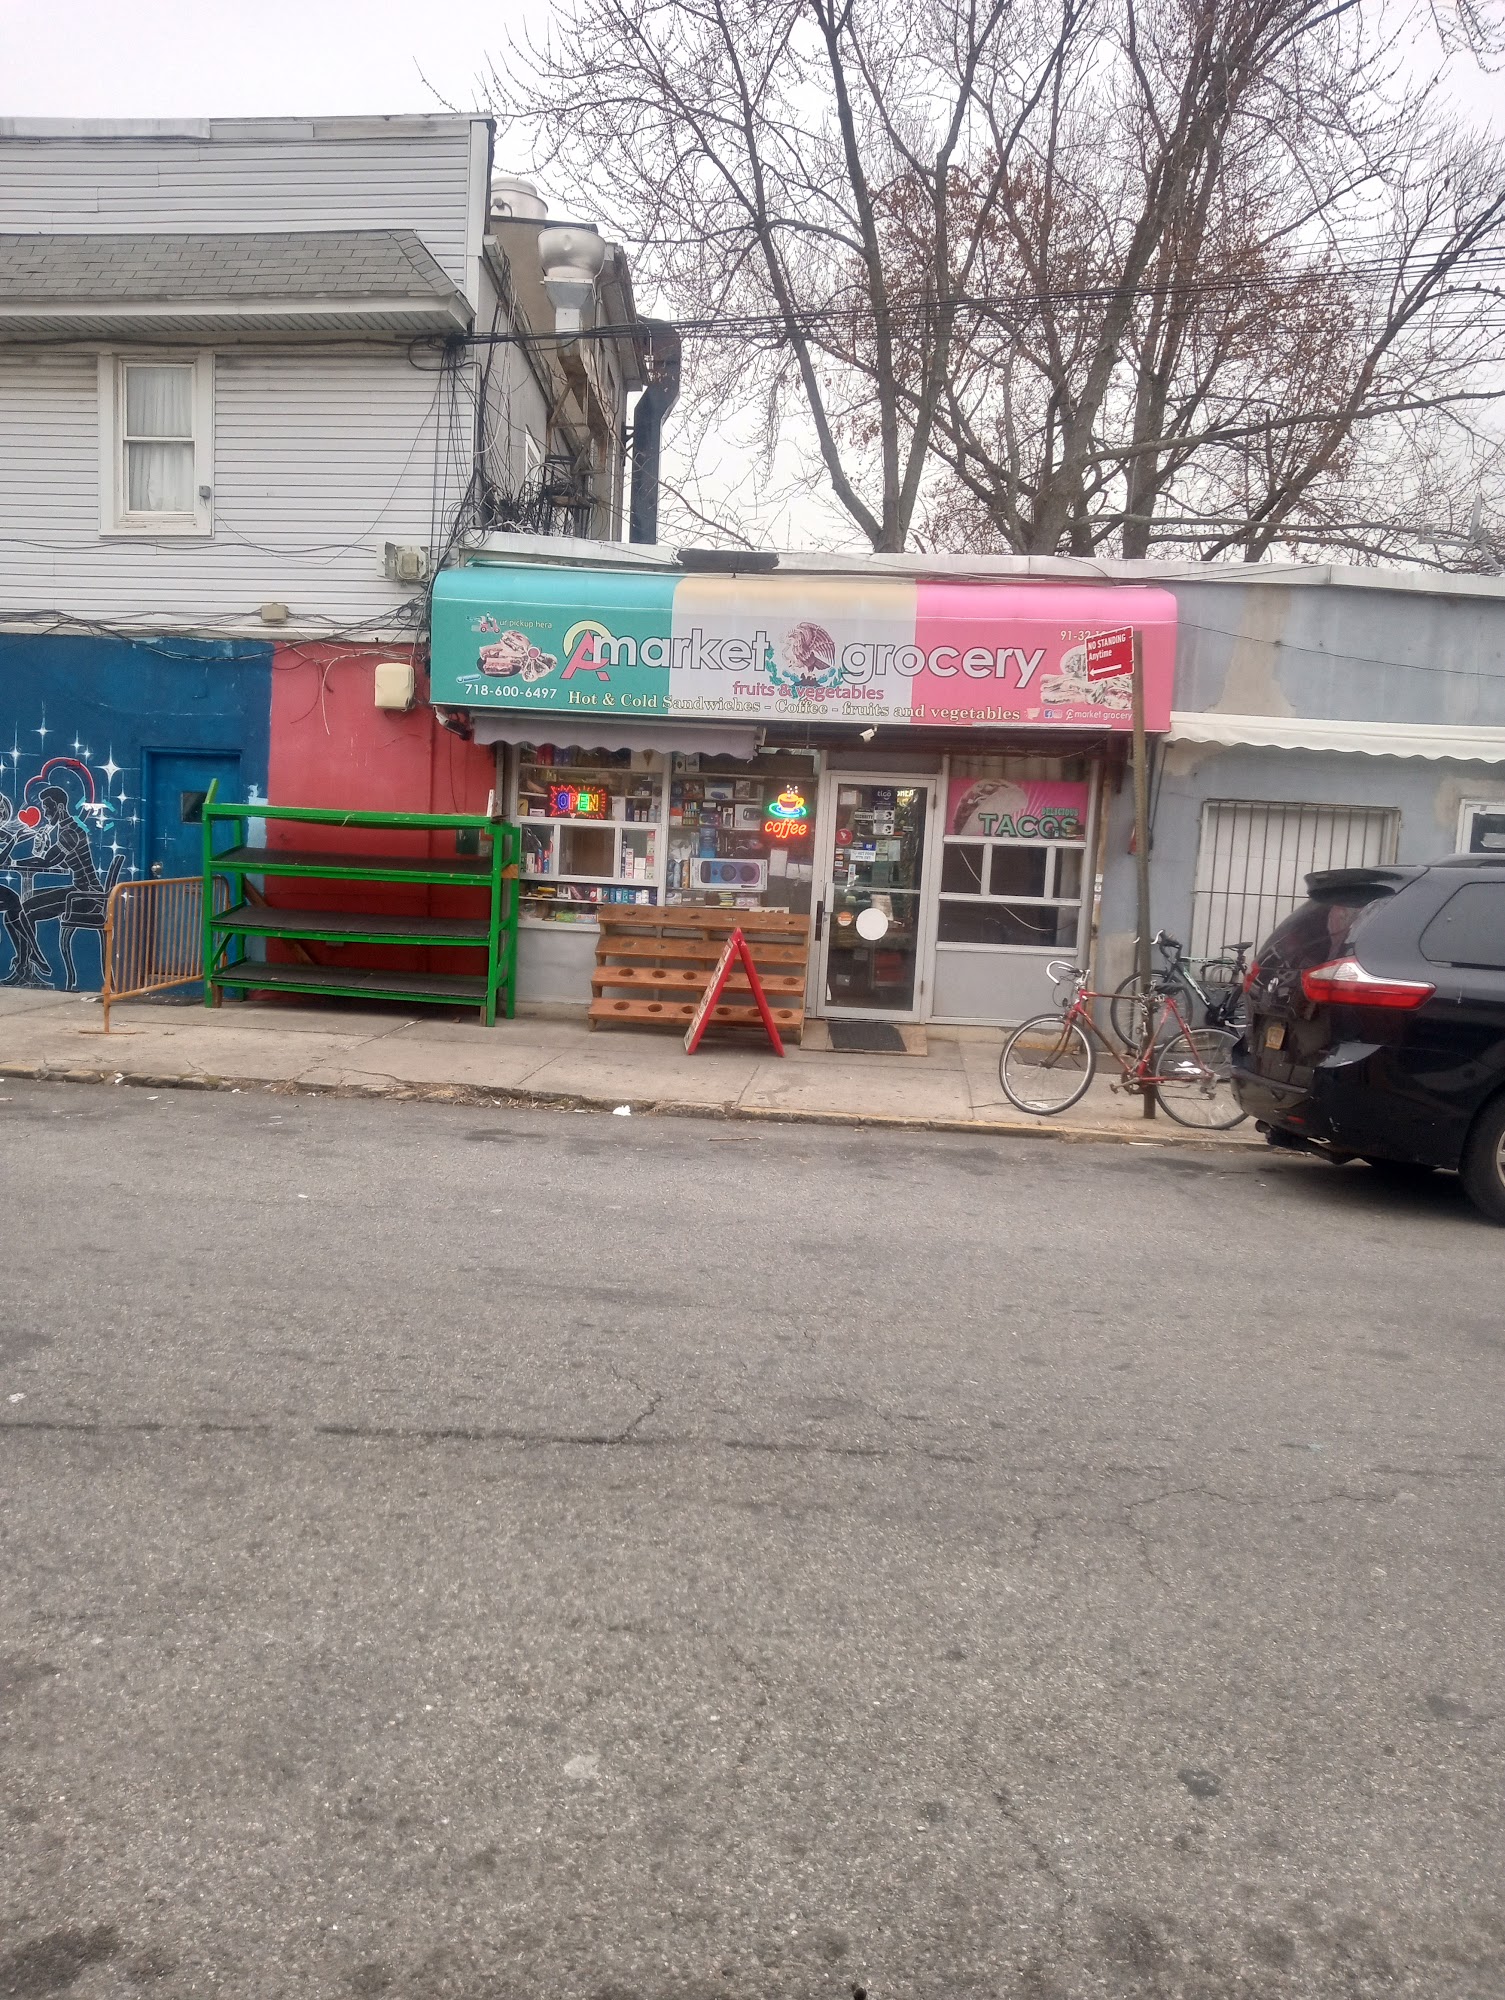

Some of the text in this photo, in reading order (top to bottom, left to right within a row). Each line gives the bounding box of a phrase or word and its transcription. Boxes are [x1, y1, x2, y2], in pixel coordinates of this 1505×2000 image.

[509, 619, 534, 629] pickup
[1088, 634, 1126, 651] NO STANDING
[1088, 649, 1113, 661] Anytime
[841, 643, 1047, 689] grocery
[465, 684, 557, 699] 718-600-6497
[733, 681, 884, 702] fruits & vegetables
[568, 690, 597, 705] Hot
[602, 692, 615, 706] &
[620, 693, 657, 708] Cold
[662, 694, 761, 713] Sandwiches
[775, 698, 828, 715] Coffee
[842, 702, 889, 717] fruits
[893, 705, 925, 717] and
[931, 705, 1020, 721] vegetables
[1074, 710, 1101, 719] market
[1103, 712, 1133, 721] grocery
[558, 792, 599, 811] OPEN
[765, 818, 807, 838] coffee
[978, 812, 1078, 839] TACOS
